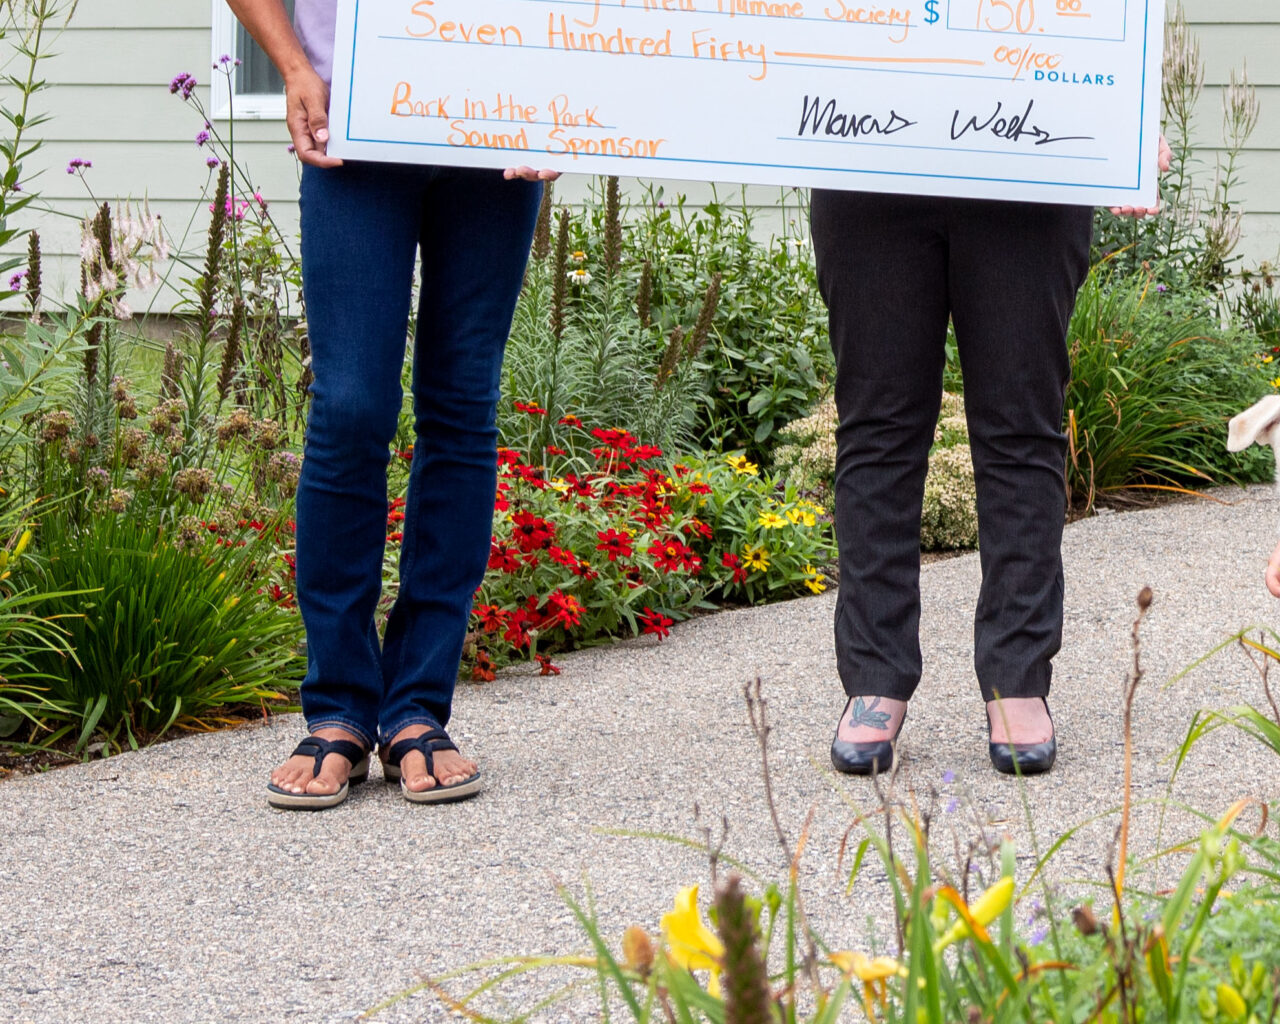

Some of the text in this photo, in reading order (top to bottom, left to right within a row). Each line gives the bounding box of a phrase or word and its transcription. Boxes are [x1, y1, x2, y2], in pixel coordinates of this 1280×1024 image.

[404, 0, 523, 47] Seven
[547, 12, 672, 58] Hundred
[1034, 69, 1115, 86] DOLLARS
[390, 81, 604, 129] Bark in the Park
[447, 119, 668, 161] Sound Sponsor
